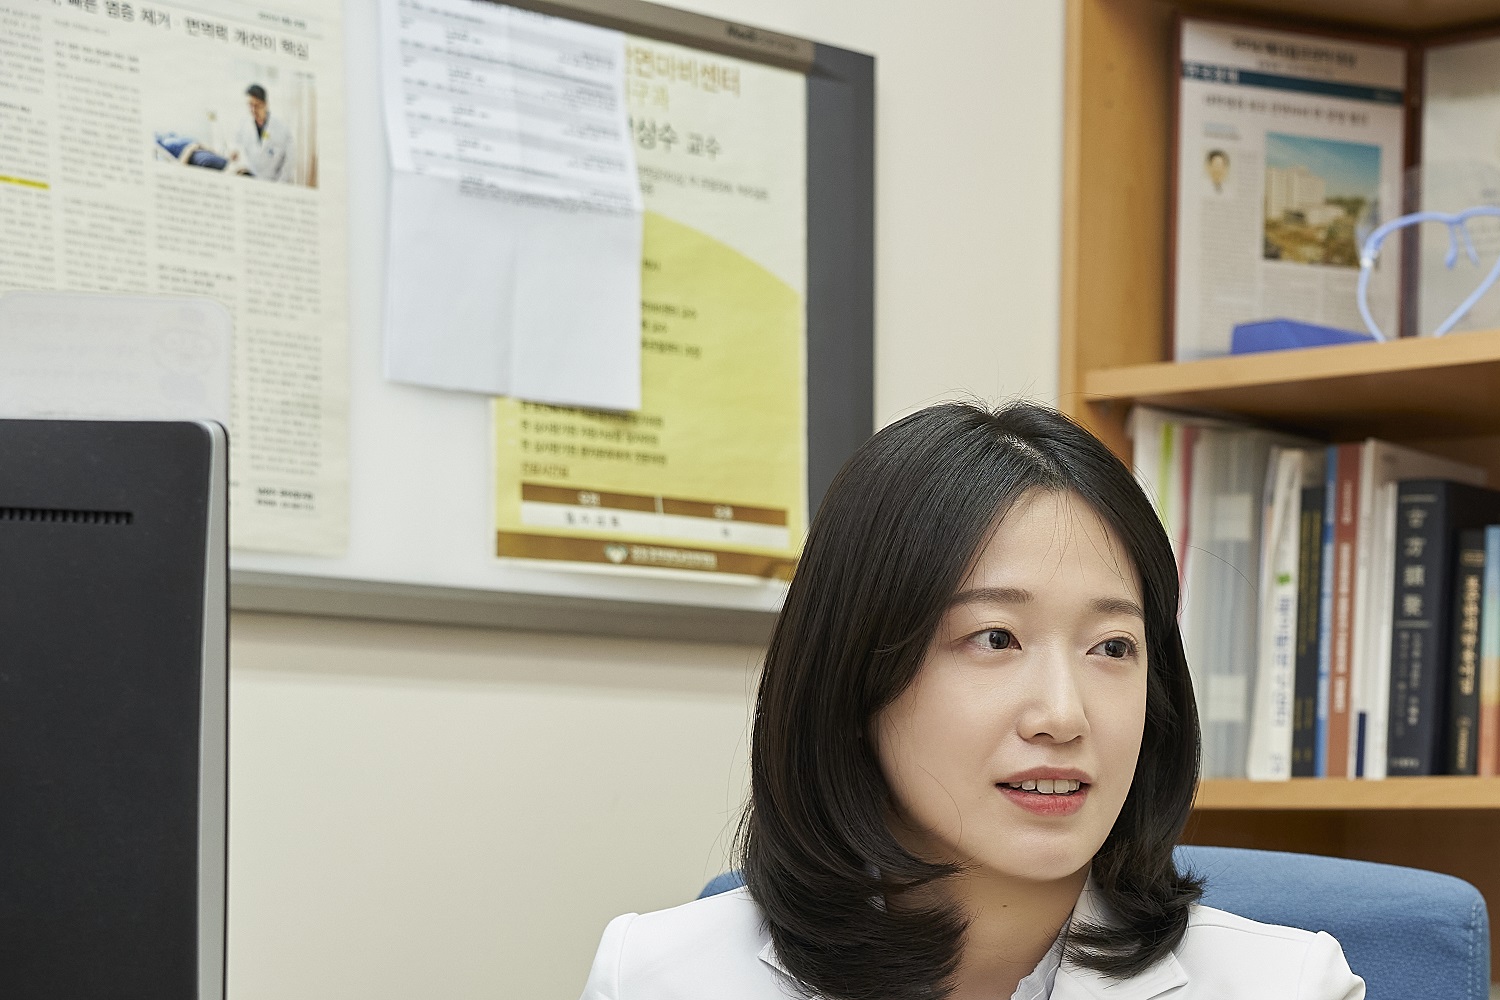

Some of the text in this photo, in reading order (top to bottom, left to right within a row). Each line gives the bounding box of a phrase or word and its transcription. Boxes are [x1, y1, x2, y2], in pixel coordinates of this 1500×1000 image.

[141, 9, 171, 29] 제거
[627, 81, 670, 111] 구과
[628, 118, 722, 160] 상수 교수
